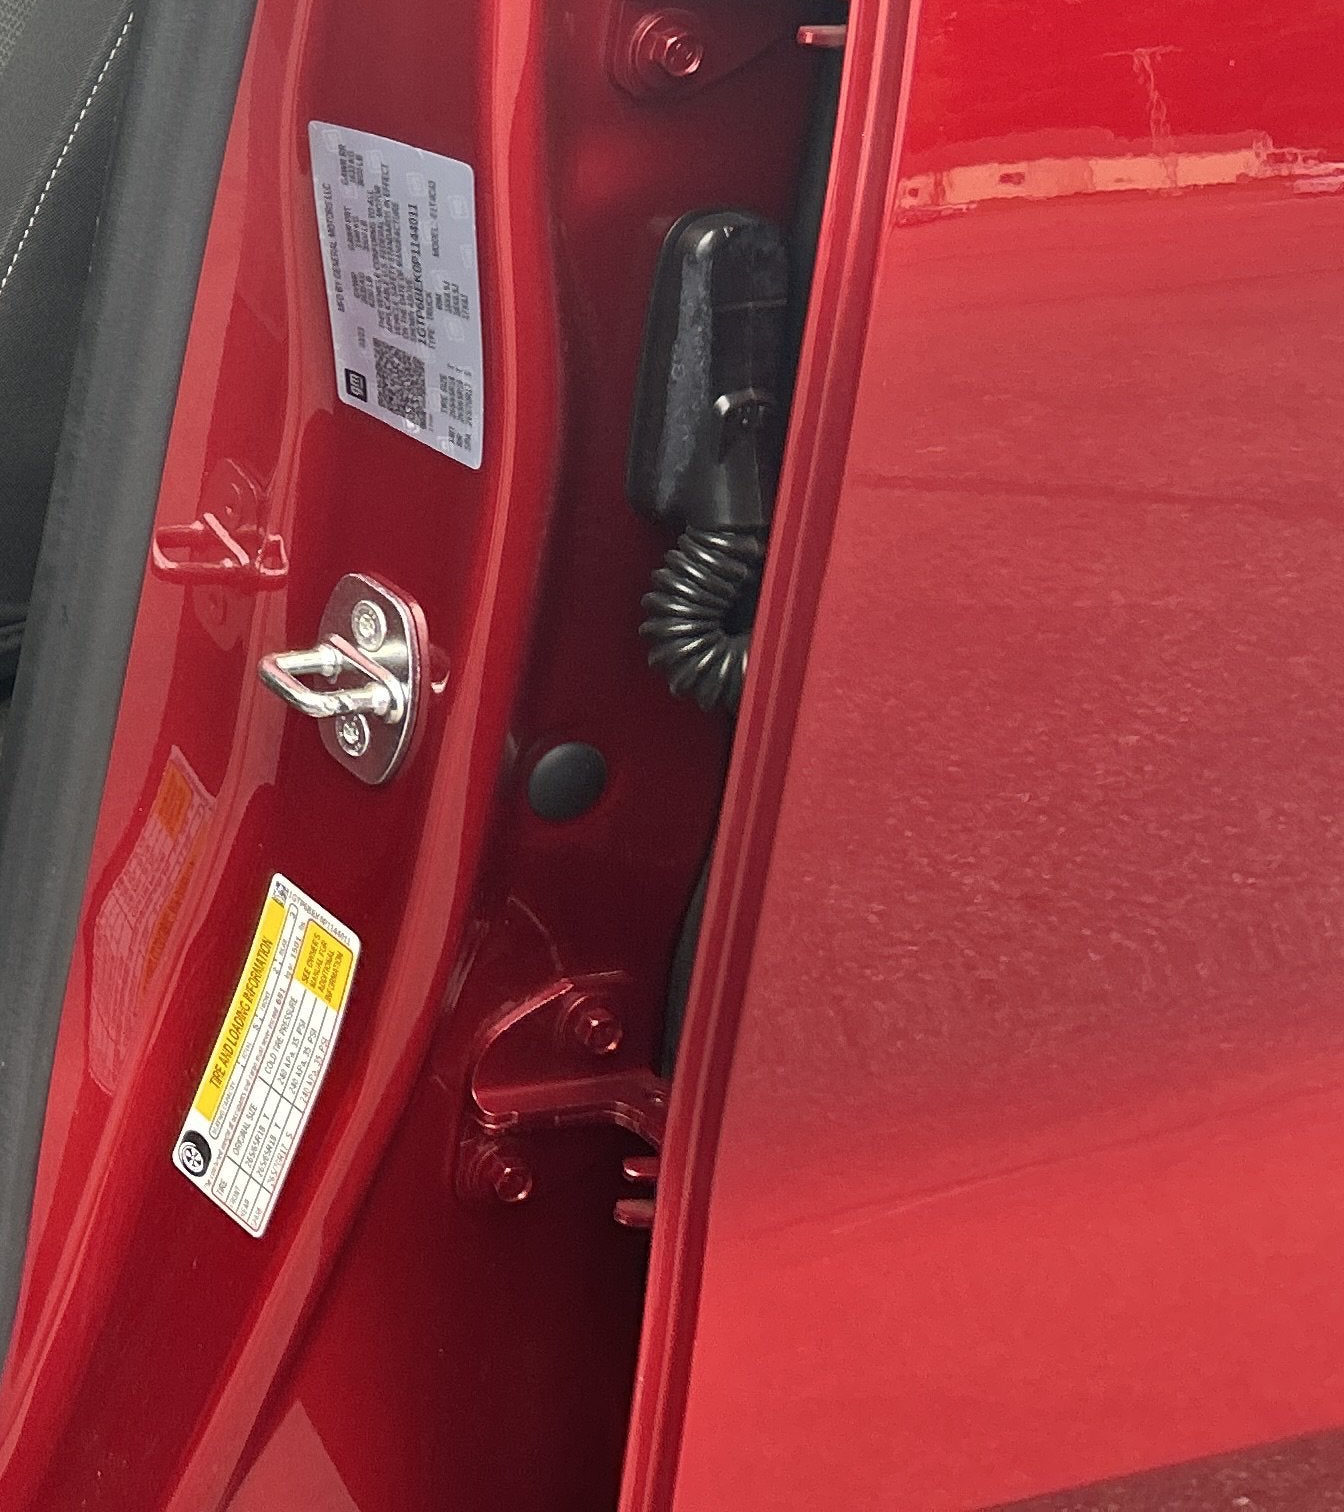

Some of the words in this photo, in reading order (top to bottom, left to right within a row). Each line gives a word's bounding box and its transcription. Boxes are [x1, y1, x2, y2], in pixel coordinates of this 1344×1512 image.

[324, 199, 336, 239] MOTORS
[328, 239, 341, 280] GENERAL
[241, 934, 273, 1004] INFORMATION
[301, 966, 311, 984] SEE
[308, 956, 324, 989] MANUAL
[318, 939, 328, 957] FOR
[316, 947, 337, 993] ADDITIONAL
[322, 949, 346, 1004] INFORMATION
[225, 998, 250, 1047] LOADING
[264, 1051, 277, 1076] COLD
[272, 1034, 284, 1054] TIRE
[278, 994, 298, 1037] PRESSURE
[295, 1017, 306, 1036] PSI
[307, 1026, 318, 1045] PSI
[217, 1040, 234, 1068] AND
[317, 1034, 328, 1053] PSI
[208, 1062, 226, 1091] TIRE
[245, 1101, 258, 1122] SIZE
[215, 1177, 228, 1198] TIRE
